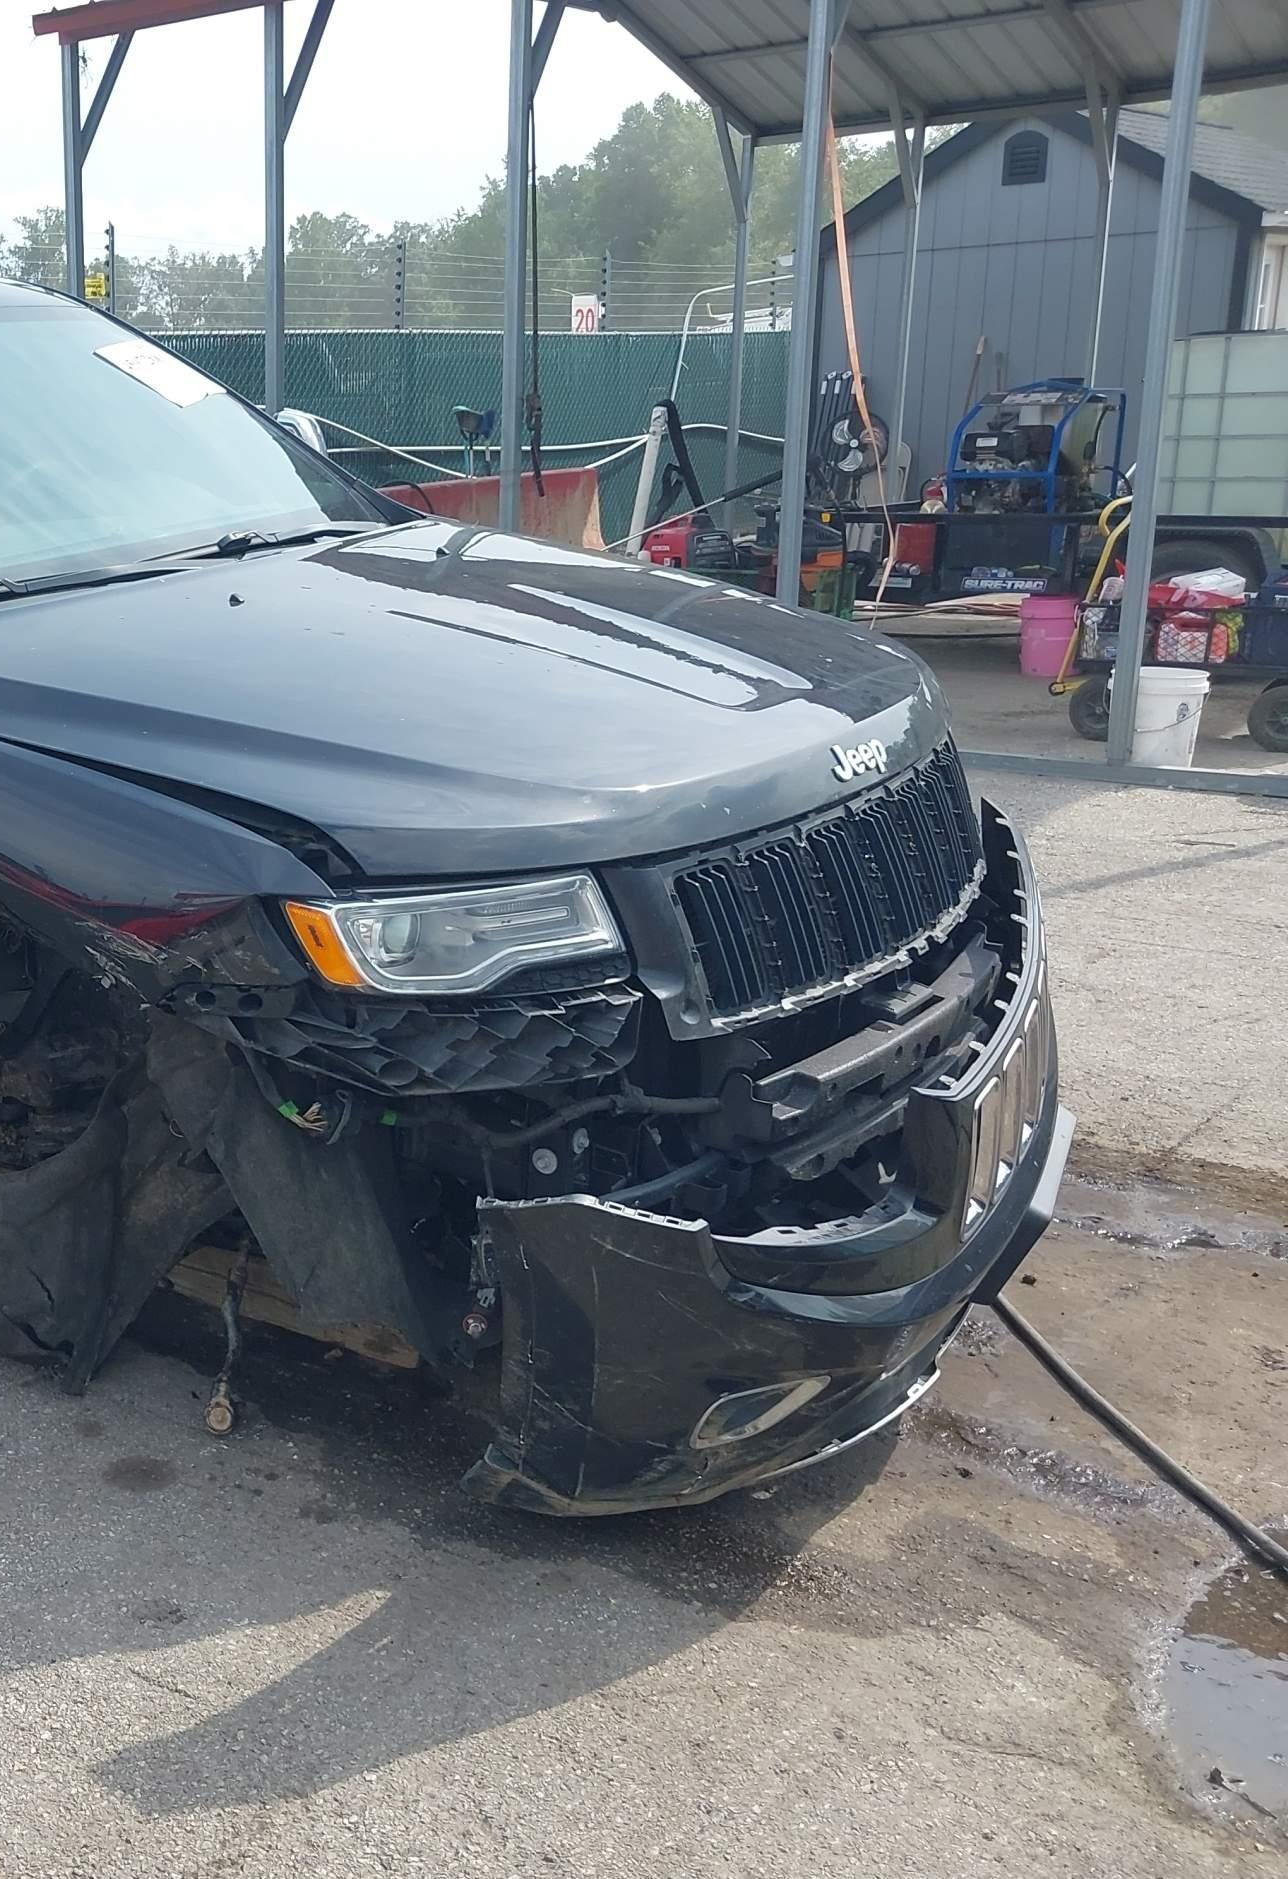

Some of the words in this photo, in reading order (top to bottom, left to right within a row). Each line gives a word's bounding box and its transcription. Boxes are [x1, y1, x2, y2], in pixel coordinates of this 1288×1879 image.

[575, 308, 595, 333] 20
[963, 579, 1045, 591] SURE-TRAC
[830, 739, 888, 783] Jeep
